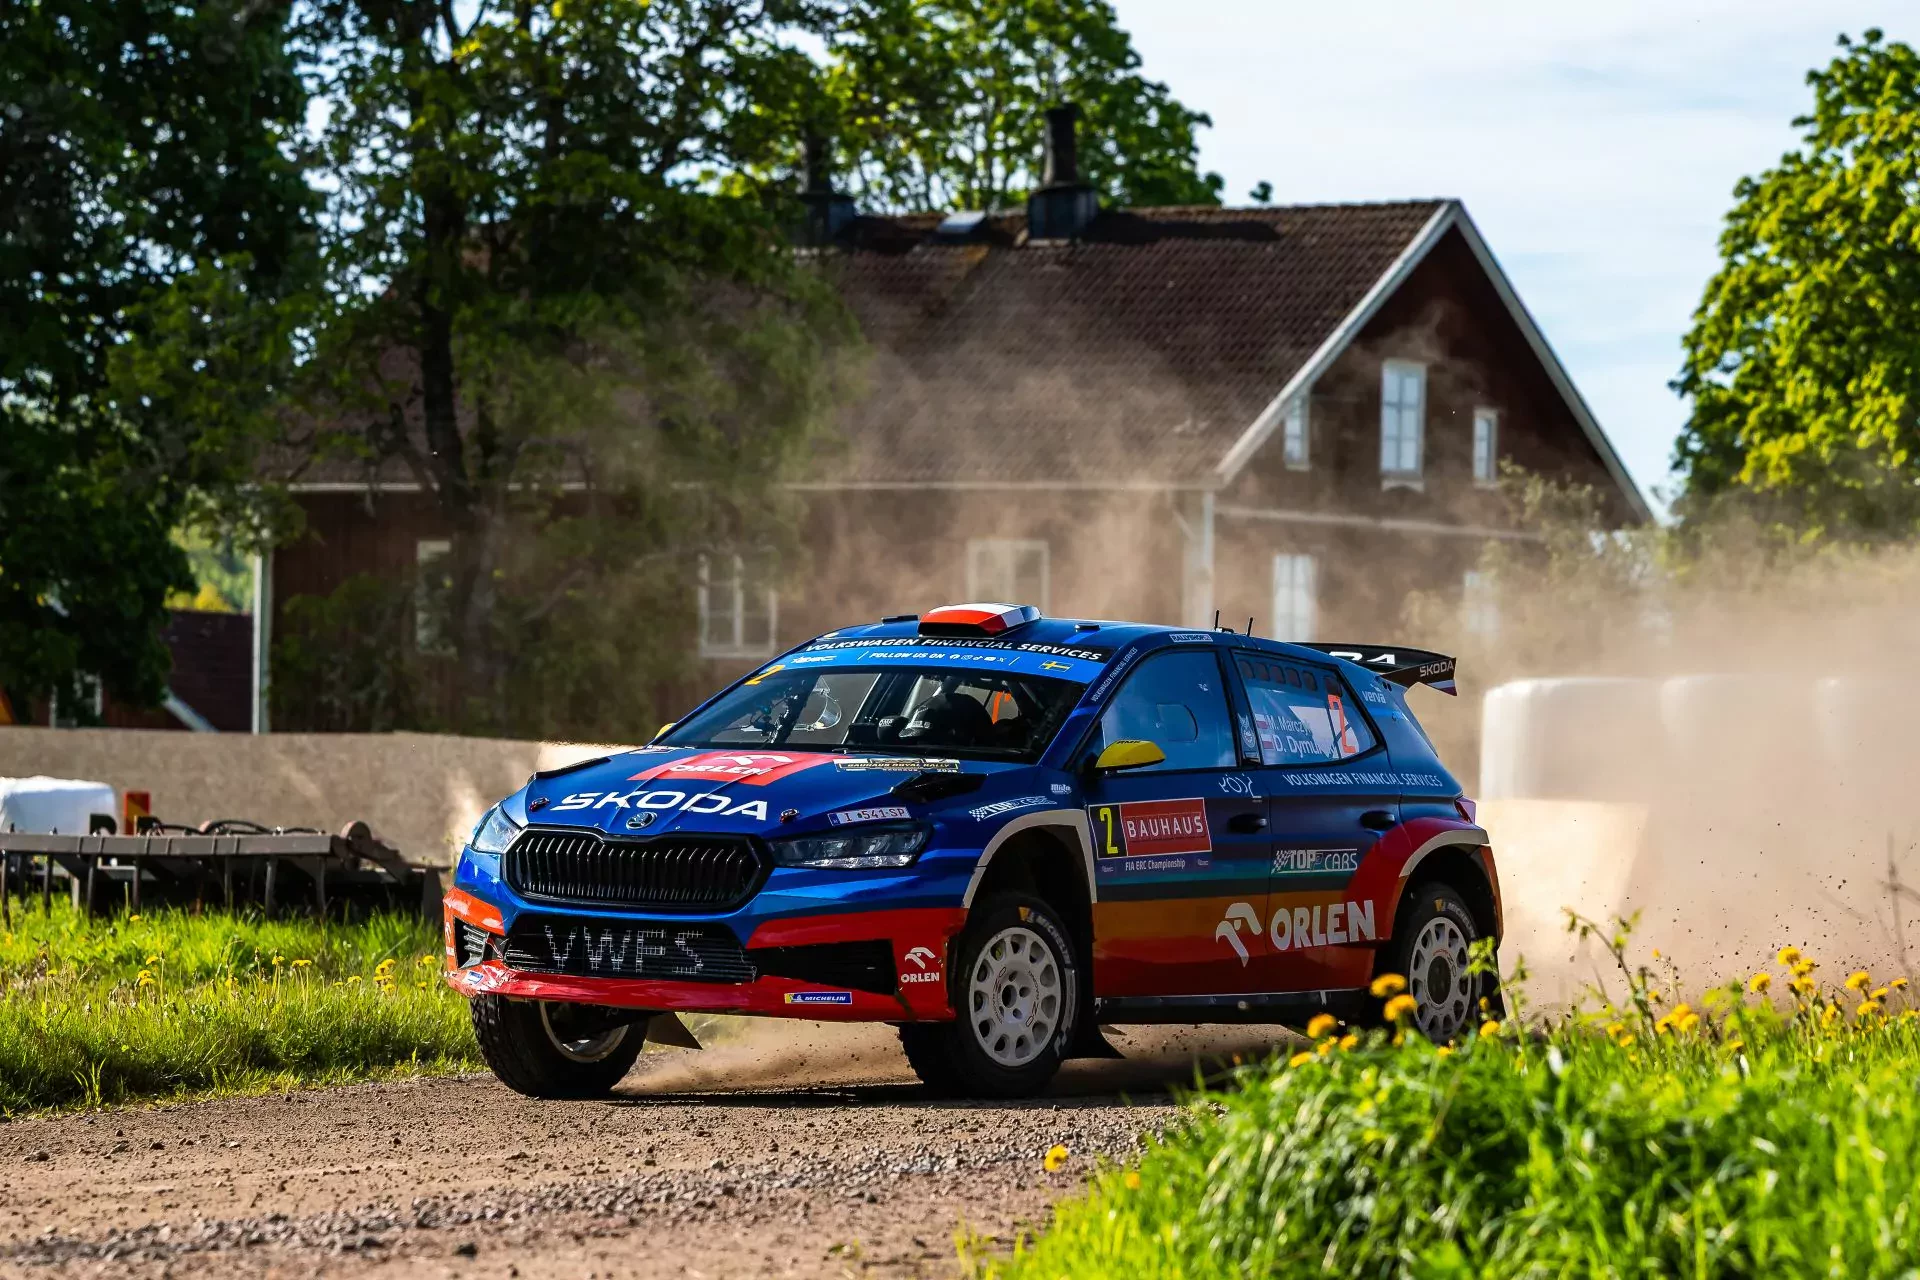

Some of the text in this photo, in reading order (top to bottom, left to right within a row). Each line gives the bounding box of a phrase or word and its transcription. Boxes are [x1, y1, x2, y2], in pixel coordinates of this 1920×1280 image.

[806, 639, 1102, 660] VOLKSWAGEN FINANCIAL SERVICES
[670, 763, 773, 775] ORLEN
[1282, 773, 1443, 787] VOLKSWAGEN FINANCIAL SERVICES
[1100, 807, 1204, 854] 2 BAUHAUS
[1125, 861, 1135, 871] FIA
[1147, 858, 1186, 871] Championship
[1325, 852, 1358, 871] CARS
[1270, 900, 1376, 951] ORLEN
[544, 925, 703, 974] VWFS
[901, 972, 939, 983] ORLEN
